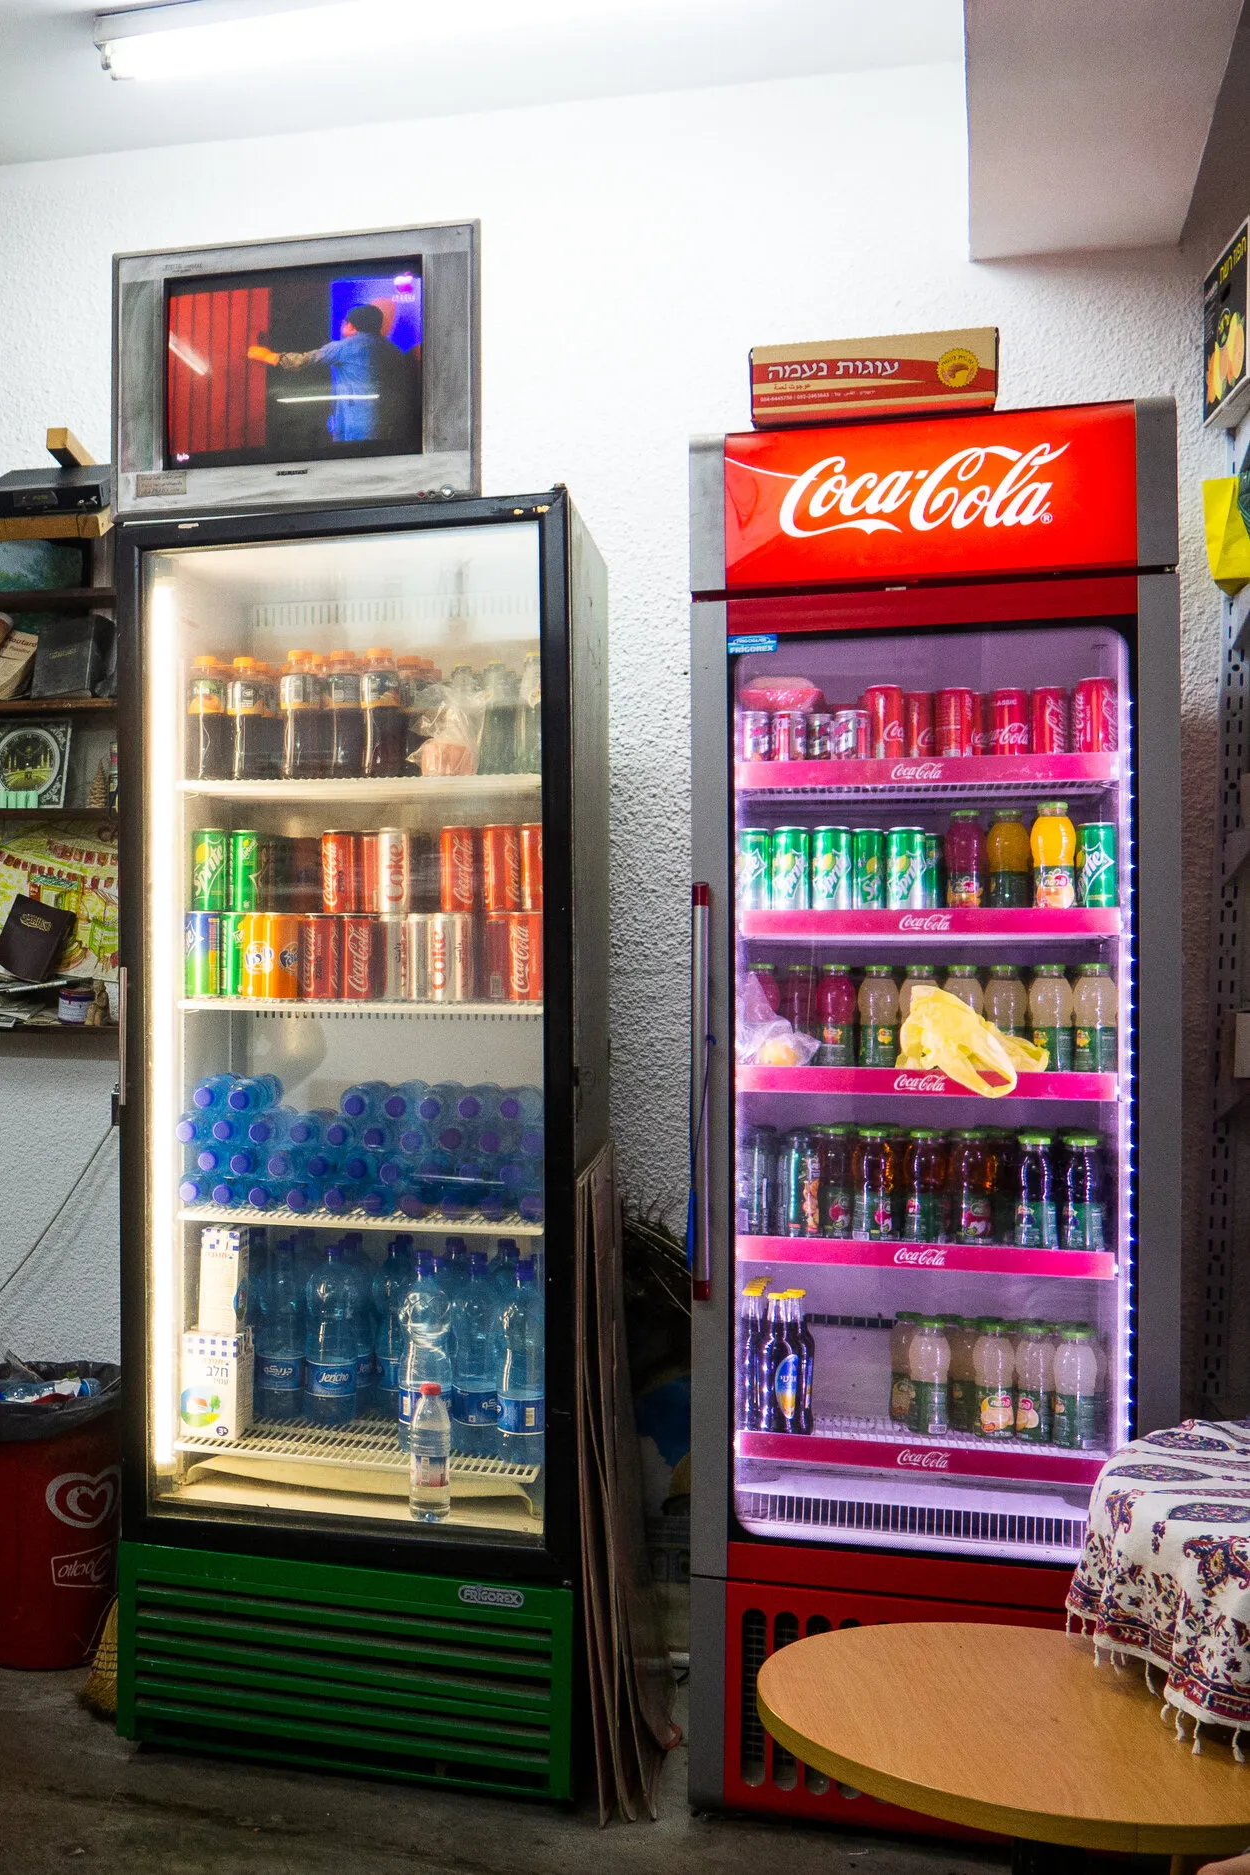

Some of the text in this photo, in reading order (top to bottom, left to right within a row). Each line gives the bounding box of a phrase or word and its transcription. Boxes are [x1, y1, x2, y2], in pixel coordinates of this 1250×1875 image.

[767, 360, 899, 380] עוגות נעמה
[779, 441, 1070, 538] Coca-Cola
[891, 762, 944, 780] Coca-Cola
[386, 843, 405, 902] Coke
[898, 914, 951, 931] Coca-Cola
[347, 922, 369, 992] Coca-Cola
[510, 924, 530, 993] Coca-Cola
[894, 1073, 947, 1092] Coca-Cola
[894, 1247, 947, 1266] Coca-Cola
[206, 1365, 229, 1378] חלב
[318, 1370, 350, 1384] Jericho
[897, 1449, 950, 1469] Coca-Cola
